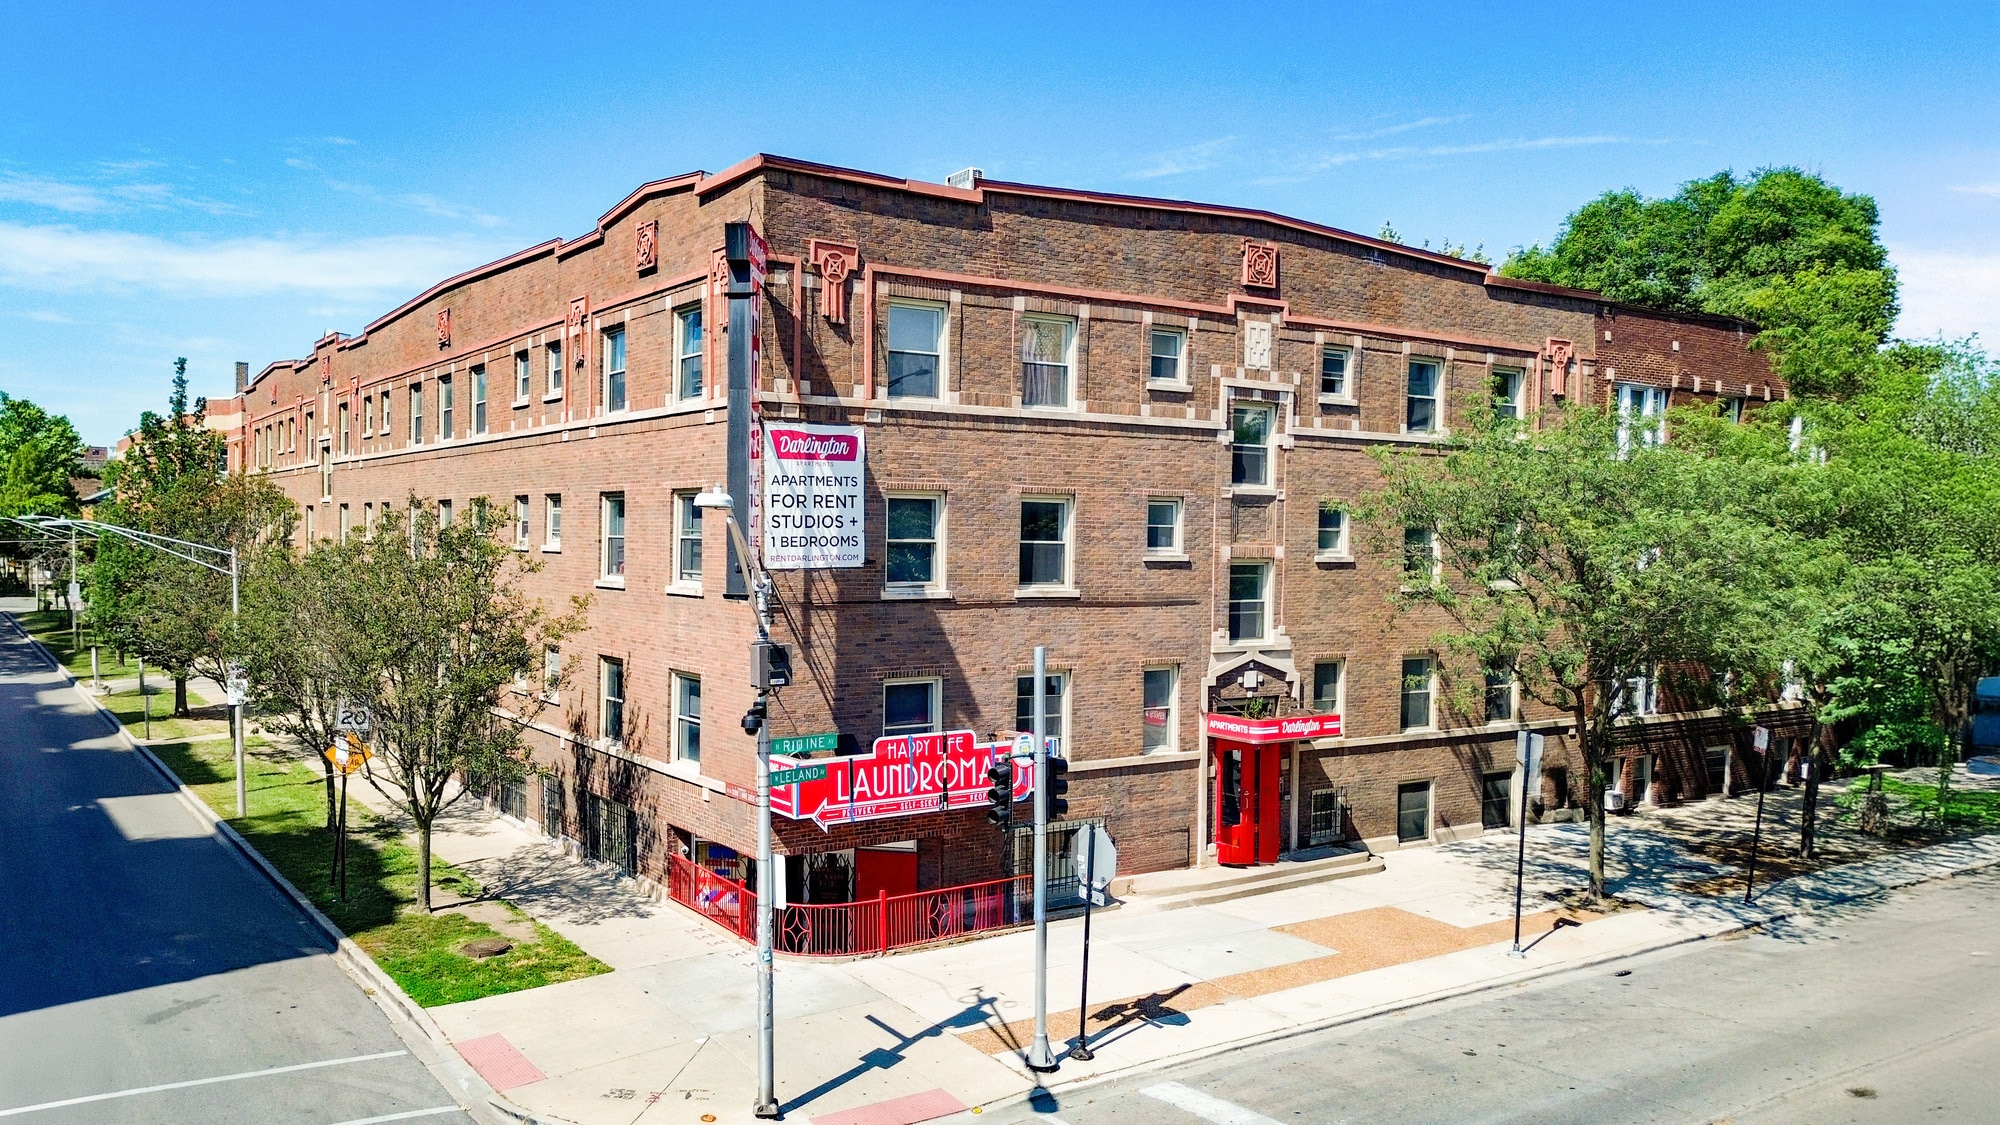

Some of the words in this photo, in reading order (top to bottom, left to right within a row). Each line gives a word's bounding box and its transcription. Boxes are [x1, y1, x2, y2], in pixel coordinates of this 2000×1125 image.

[780, 435, 850, 458] Darlington
[771, 475, 858, 487] APARTMENTS
[771, 494, 807, 509] FOR
[813, 495, 857, 509] RENT
[771, 515, 844, 528] STUDIOS
[771, 536, 776, 548] 1
[780, 535, 859, 548] BEDROOMS
[770, 554, 859, 562] RENTDARLINGTON.COM
[341, 710, 367, 725] 20
[1209, 719, 1249, 734] APARTMENTS
[1281, 719, 1321, 735] Darlington
[887, 738, 930, 759] HAPPY
[937, 736, 963, 755] LFE
[780, 767, 819, 783] LELAND
[838, 754, 1002, 800] LAUNDROMA
[842, 805, 877, 817] DEIVERY
